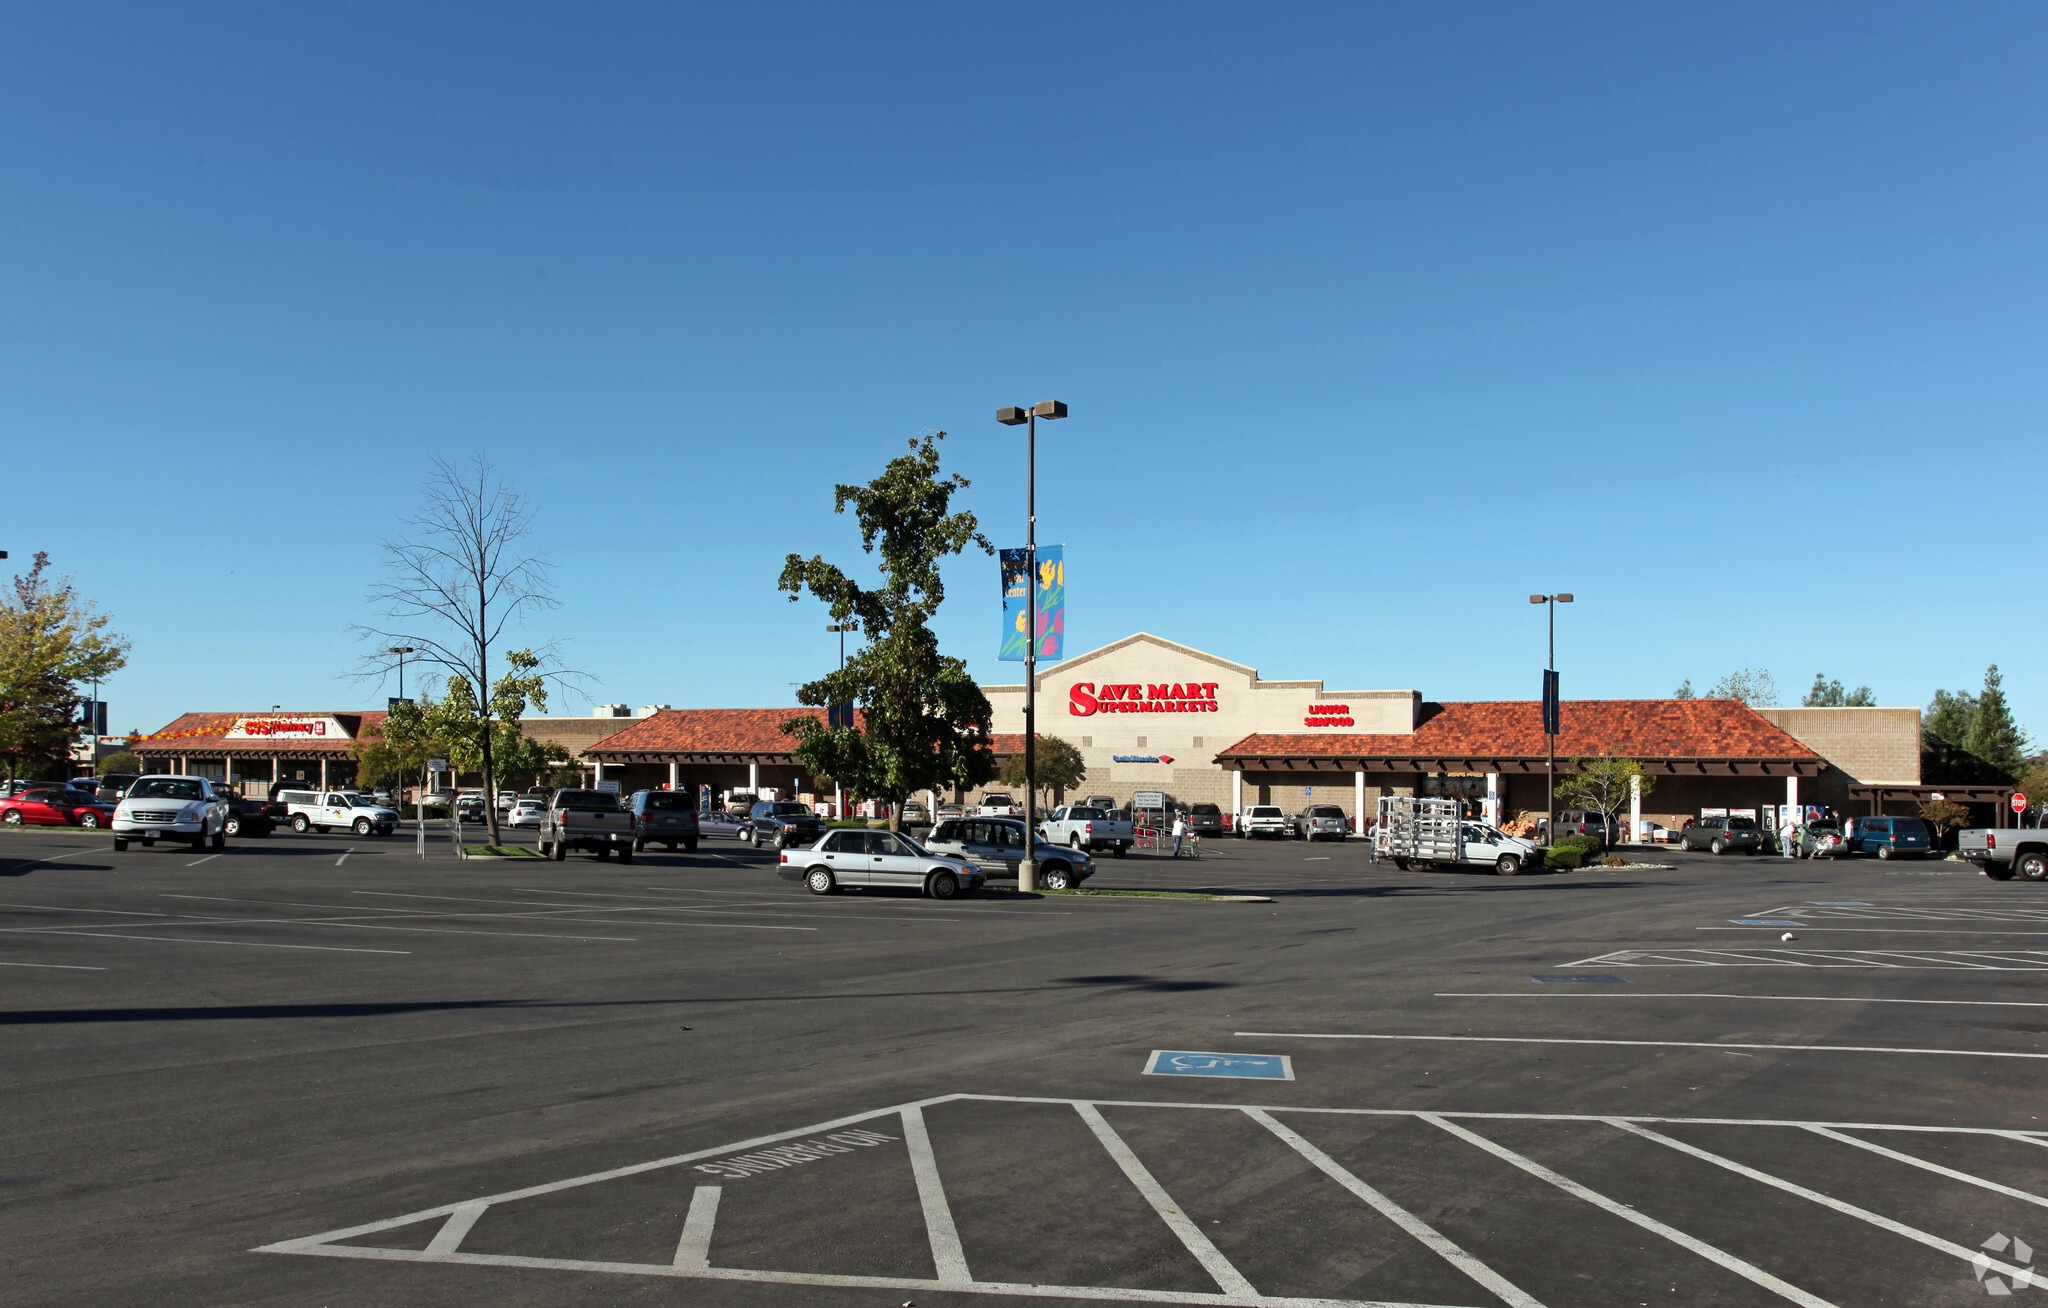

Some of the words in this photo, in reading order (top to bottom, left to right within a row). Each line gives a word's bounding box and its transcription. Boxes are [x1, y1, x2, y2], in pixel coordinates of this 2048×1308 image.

[1069, 682, 1142, 716] SAVE
[1147, 682, 1219, 700] MART
[1308, 704, 1349, 715] LIQUOR
[1304, 716, 1355, 727] SEAFOOD
[2012, 799, 2026, 807] STOP
[826, 1129, 900, 1147] NO
[694, 1140, 855, 1178] PARKING
